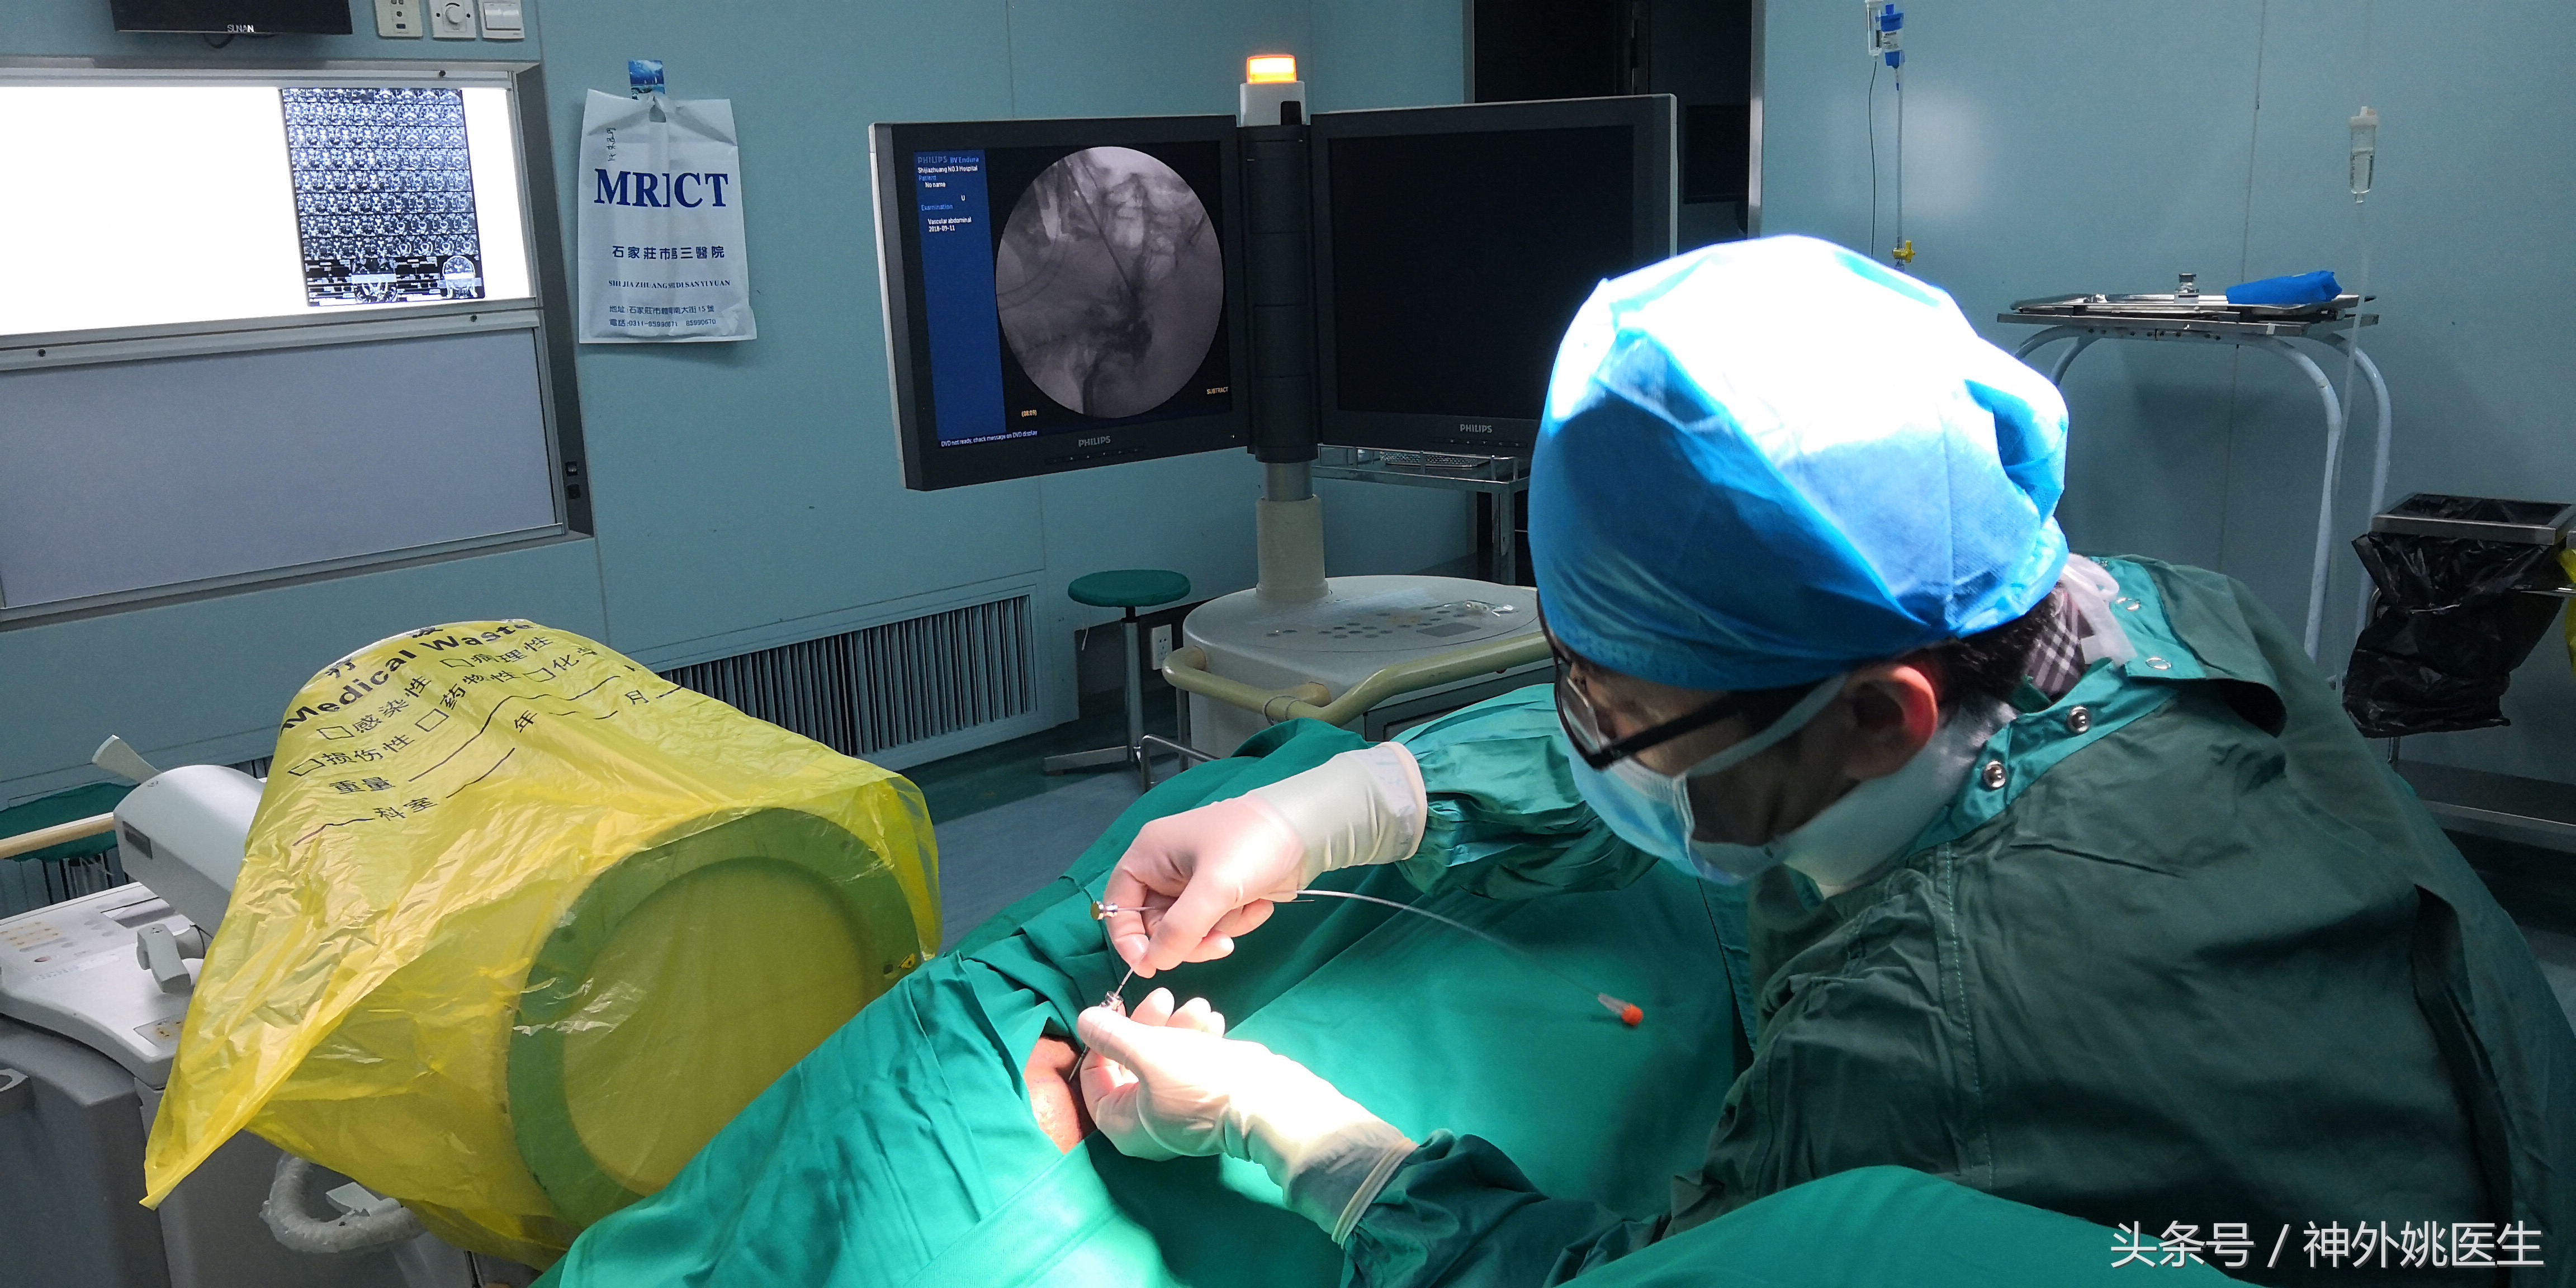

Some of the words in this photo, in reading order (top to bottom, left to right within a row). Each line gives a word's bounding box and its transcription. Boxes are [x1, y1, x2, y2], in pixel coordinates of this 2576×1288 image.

[1078, 435, 1111, 447] PHILIPS
[1460, 424, 1493, 433] PHILIPS
[280, 649, 418, 737] Medical
[419, 623, 533, 651] Waste
[321, 734, 415, 765] 损伤性
[440, 669, 522, 710] 药物性
[352, 675, 432, 733] 感染性
[470, 636, 553, 664] 病理性
[328, 776, 396, 794] 重量
[372, 797, 438, 821] 科室
[514, 710, 538, 733] 年
